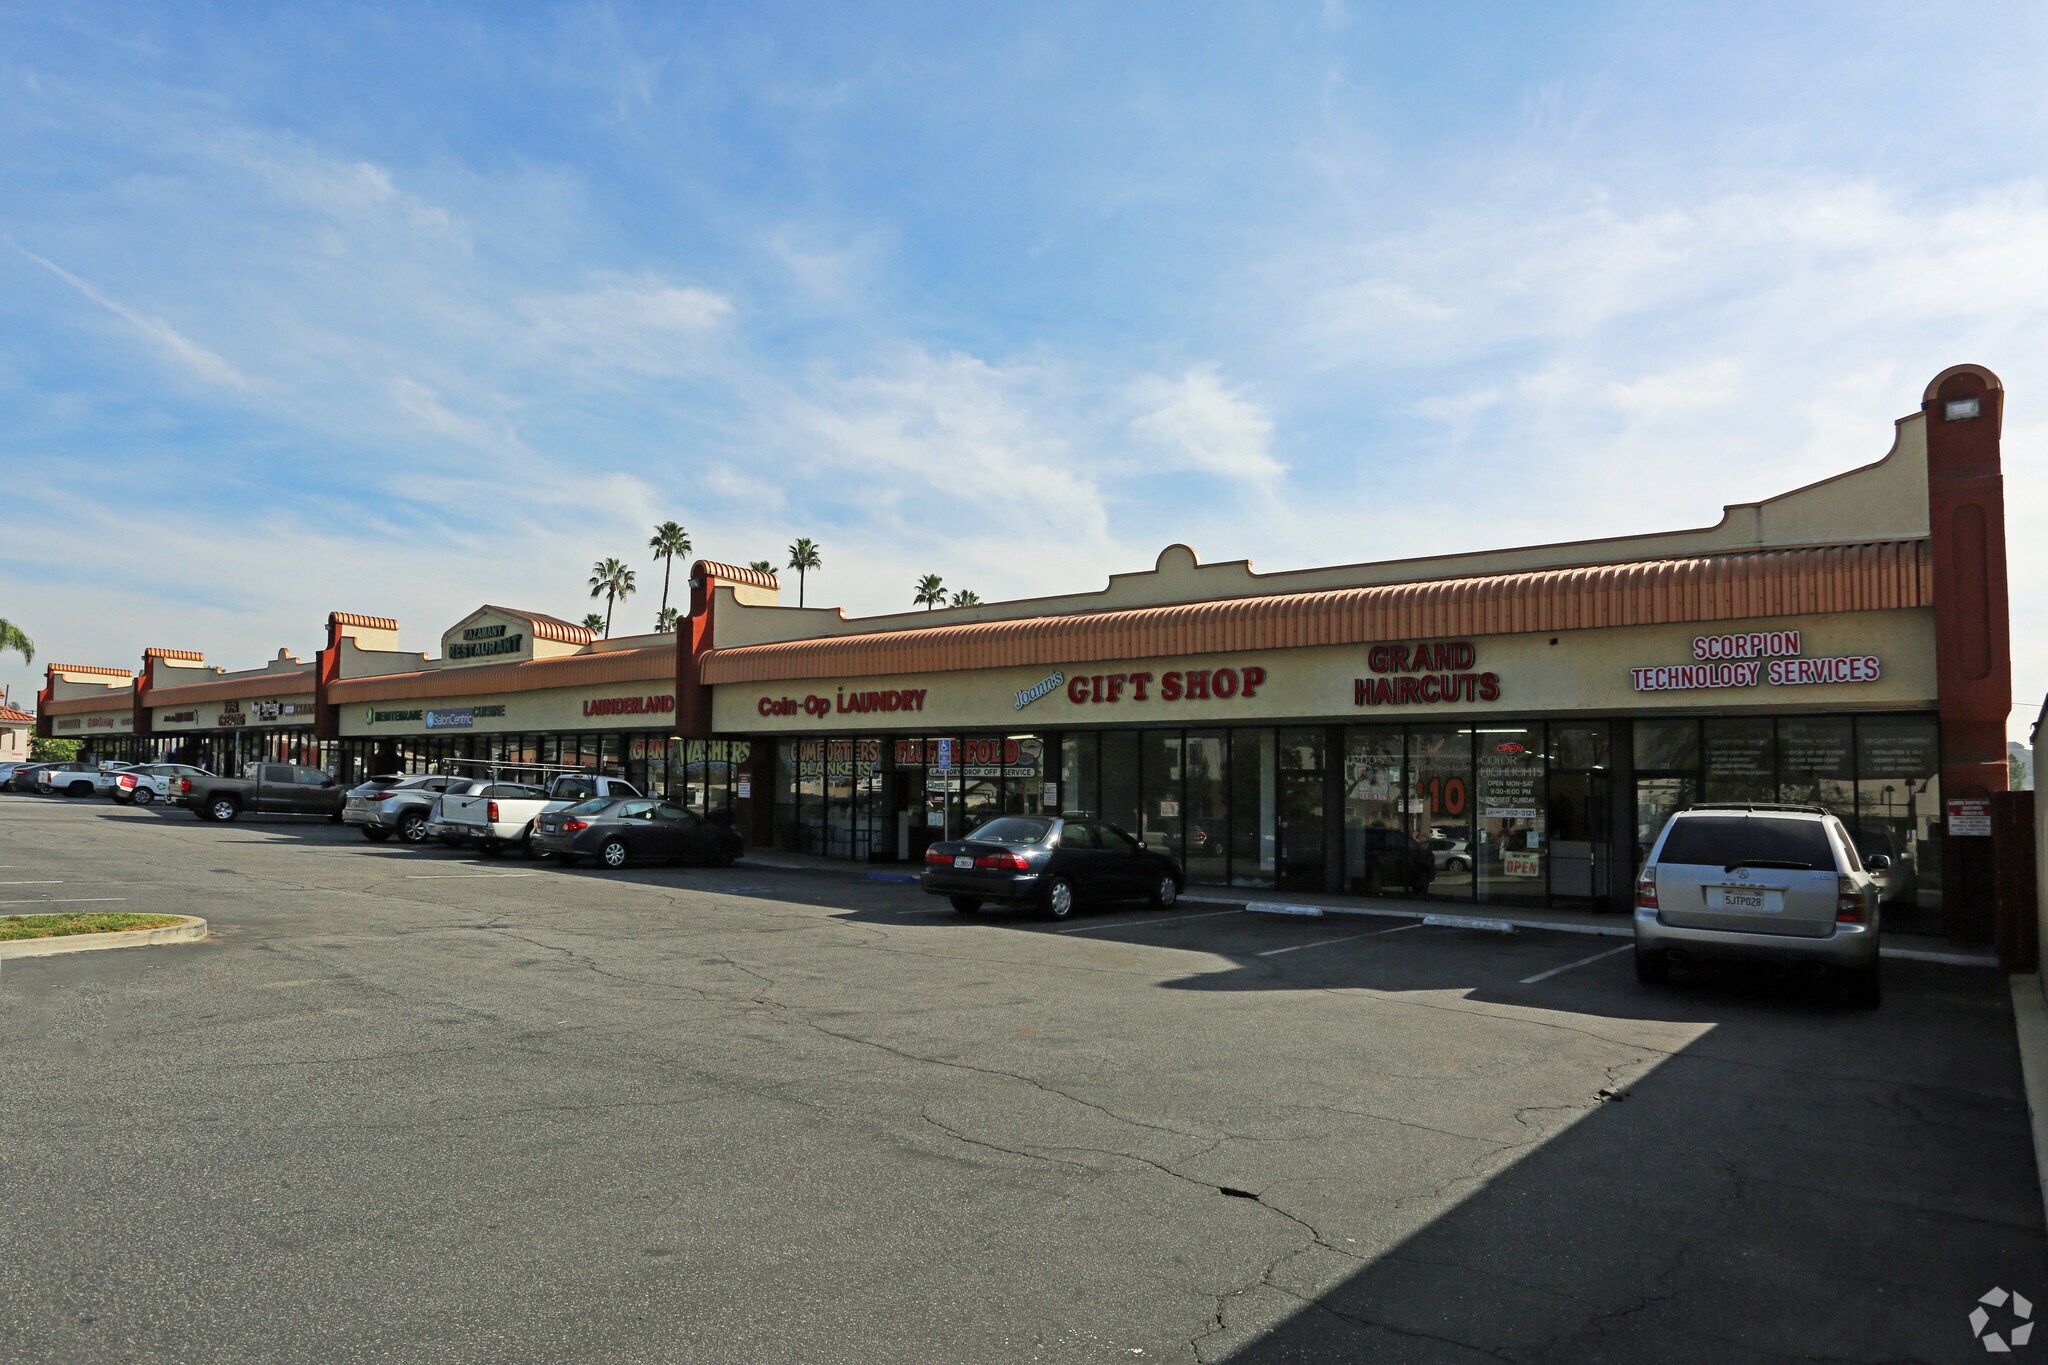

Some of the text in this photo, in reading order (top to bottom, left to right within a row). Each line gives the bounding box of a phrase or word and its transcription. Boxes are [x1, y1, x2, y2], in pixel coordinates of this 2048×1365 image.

[463, 625, 506, 640] MAZAMANY
[449, 634, 522, 659] RESTAURANT
[1693, 631, 1801, 660] SCORPION
[1368, 642, 1476, 673] GRAND
[1630, 656, 1880, 691] TECHNOLOGY SERVICES
[1015, 671, 1064, 710] Joann's
[1067, 667, 1267, 704] GIFT SHOP
[1354, 672, 1500, 706] HAIRCUTS
[472, 705, 506, 718] CUISINE
[583, 695, 675, 717] LAUNDERLAND
[758, 689, 927, 719] Coin-Op LAUNDRY
[434, 714, 472, 726] SalonCentric
[965, 739, 1019, 765] FOLD
[1496, 744, 1524, 753] OPEN
[1480, 755, 1518, 766] COLOR
[799, 761, 871, 777] BLANKETS
[964, 768, 981, 777] DROP
[984, 768, 998, 776] OFF
[1003, 767, 1031, 776] SERVICE
[1480, 767, 1545, 778] HIGHLIGHTS
[1487, 780, 1504, 788] OPEN
[1512, 796, 1536, 804] SUNDAY
[1506, 861, 1537, 875] OPEN
[1725, 895, 1761, 907] 5JTP028
